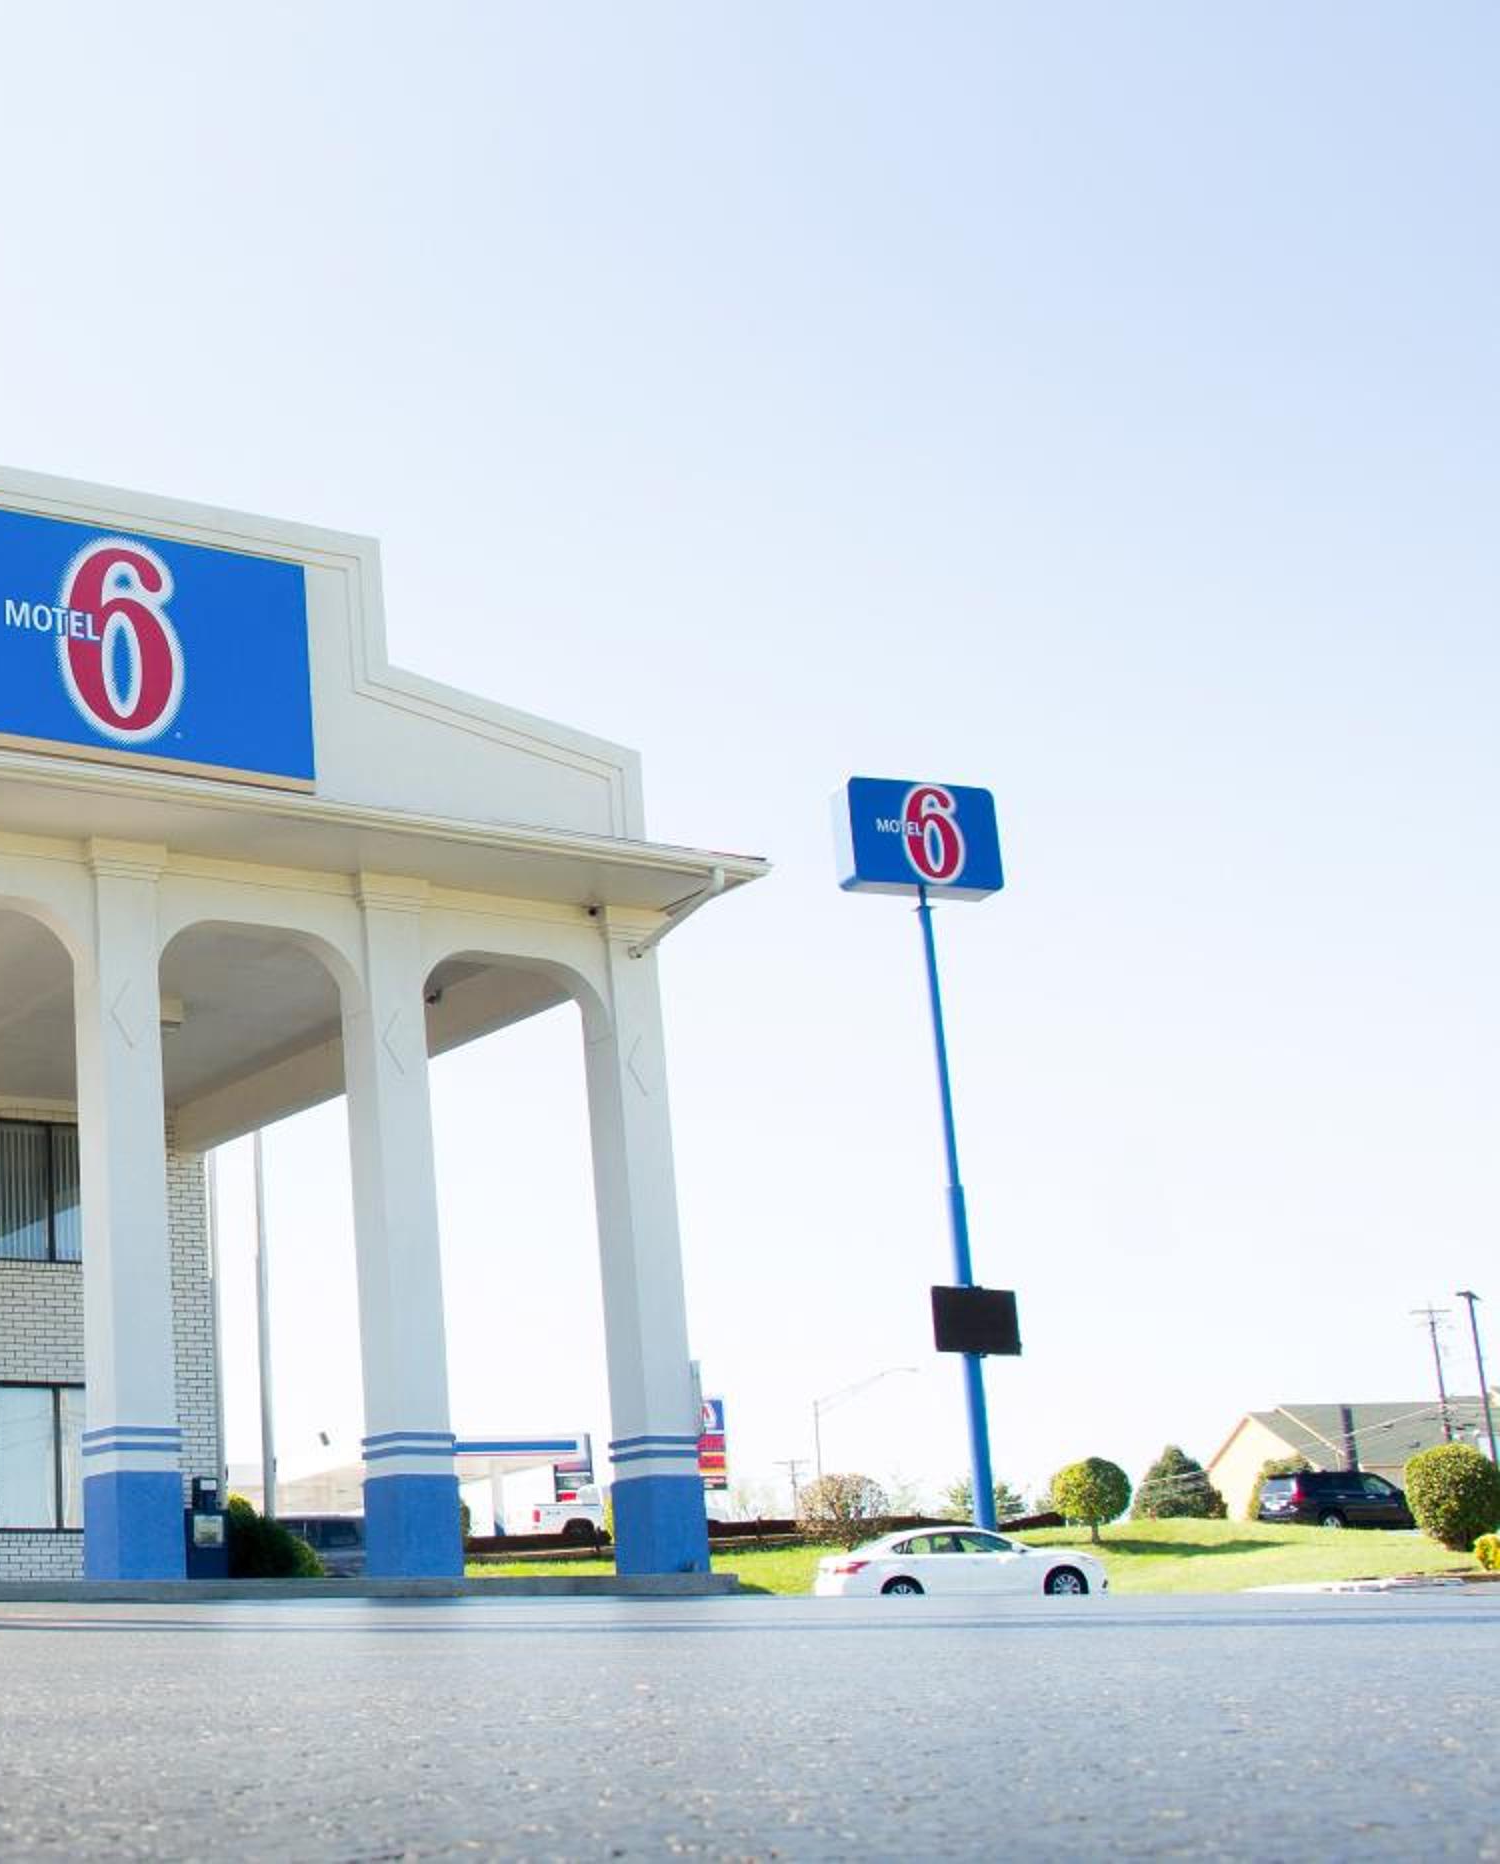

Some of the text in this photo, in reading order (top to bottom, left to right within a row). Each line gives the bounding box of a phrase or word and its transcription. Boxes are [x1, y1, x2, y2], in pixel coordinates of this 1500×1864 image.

[4, 540, 180, 739] MOTEL 6
[876, 785, 963, 882] MOTEL 6
